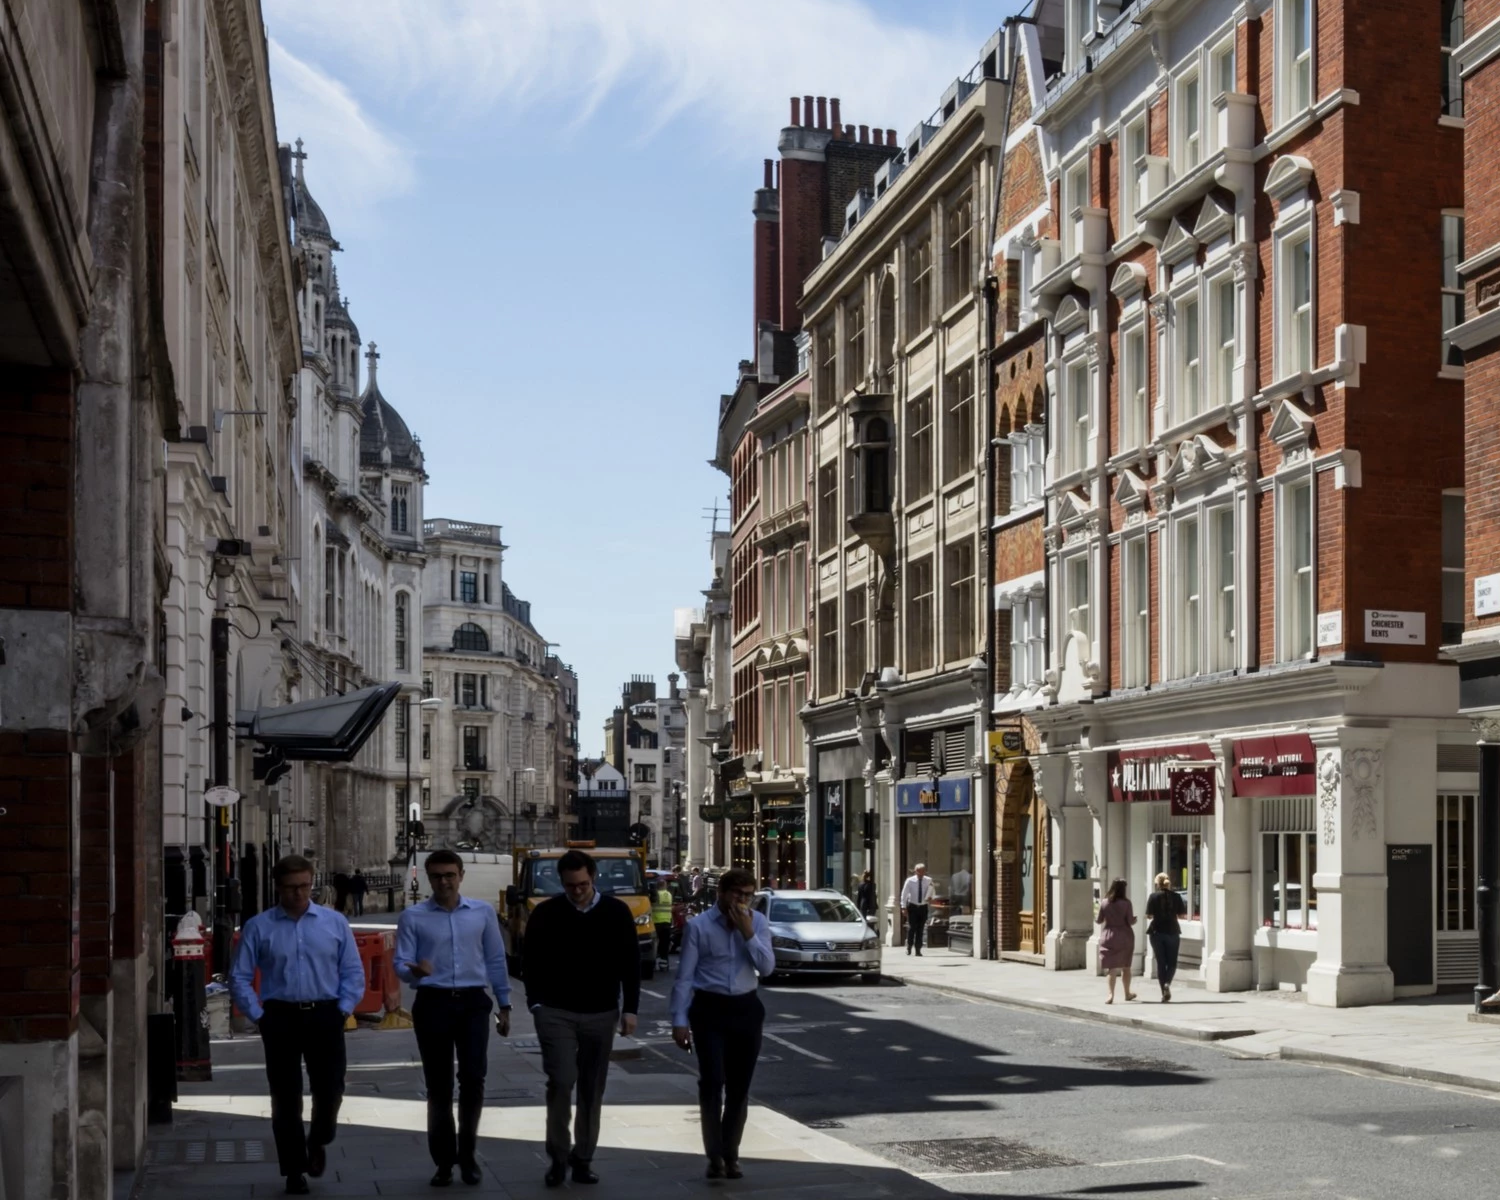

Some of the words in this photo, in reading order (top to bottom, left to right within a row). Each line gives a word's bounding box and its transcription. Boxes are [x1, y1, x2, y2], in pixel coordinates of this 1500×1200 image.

[1371, 619, 1404, 629] CHICHESTER
[1371, 629, 1389, 638] RENTS
[1240, 756, 1265, 766] ORGANIC
[1277, 753, 1302, 764] NATURAL
[1242, 768, 1263, 779] COFFEE
[1282, 766, 1298, 776] FOOD
[1175, 774, 1194, 793] ORGANIC
[1196, 774, 1212, 792] COFFEE
[1177, 798, 1199, 813] NATURAL
[1200, 798, 1211, 810] FOOD
